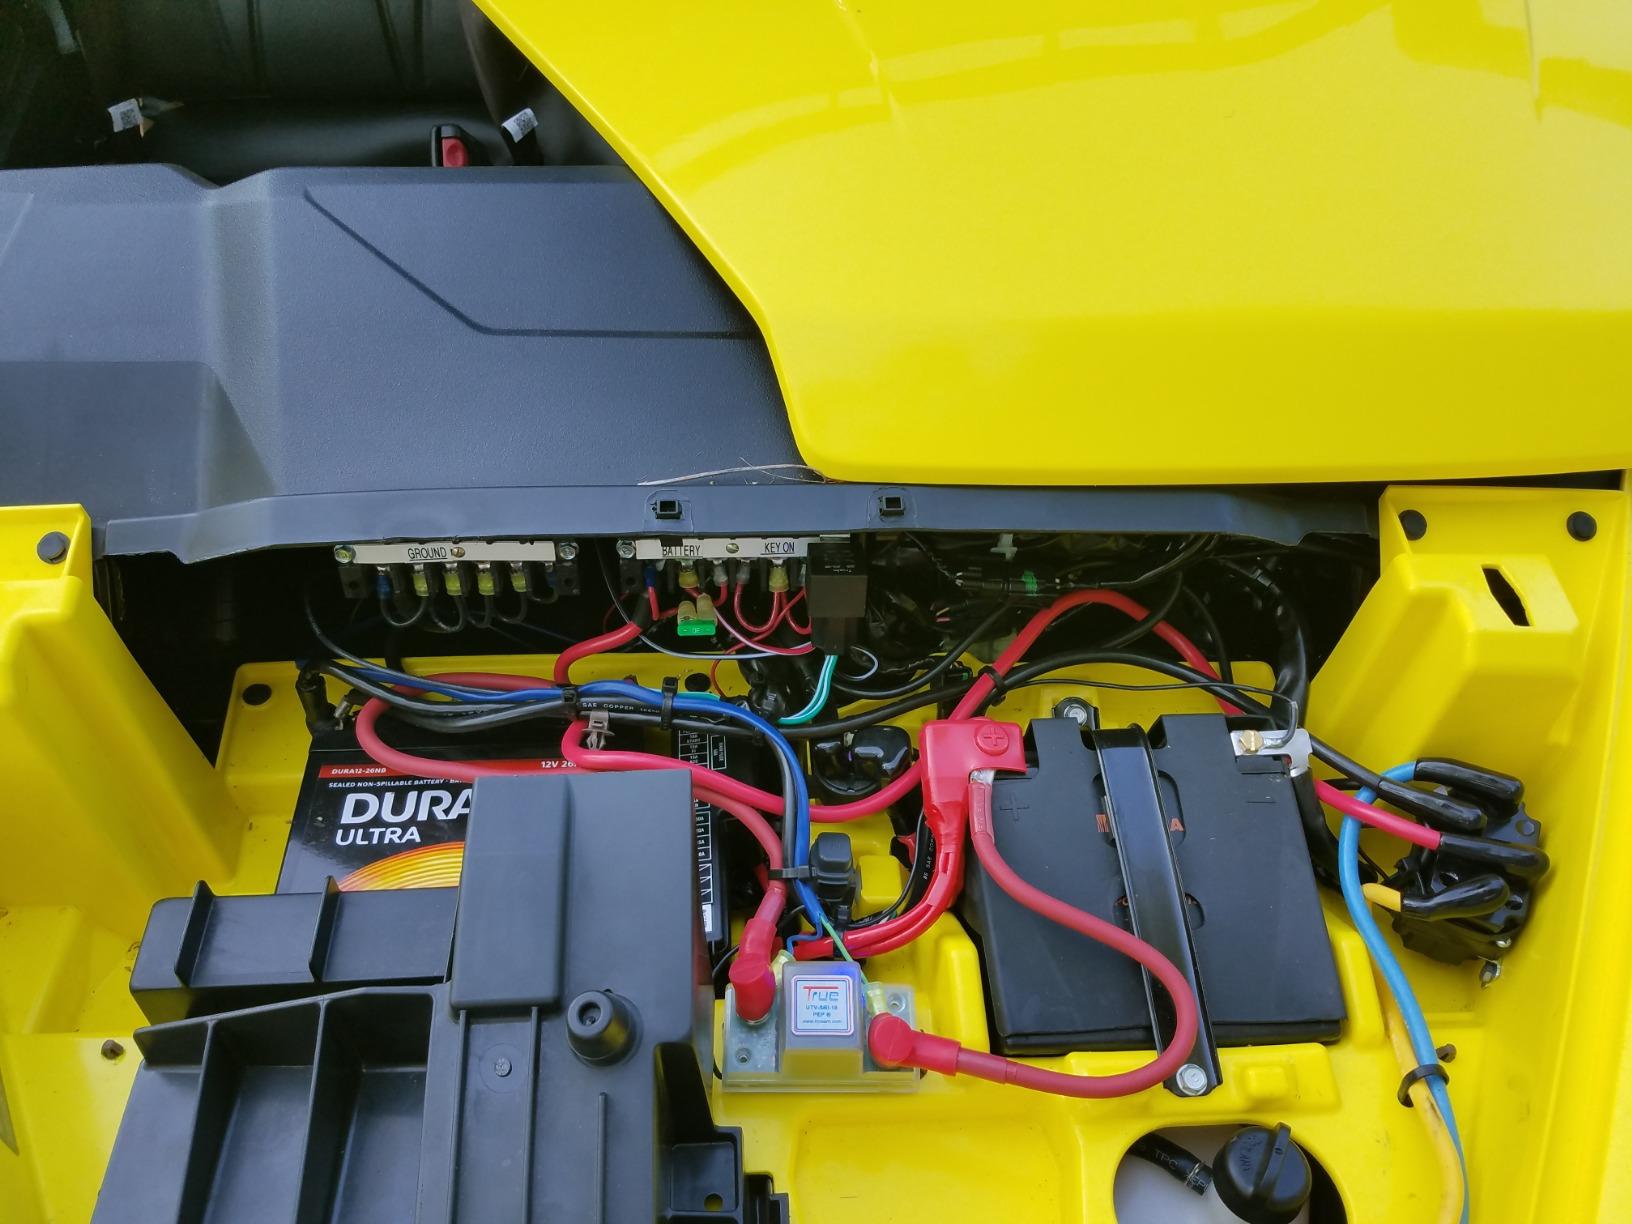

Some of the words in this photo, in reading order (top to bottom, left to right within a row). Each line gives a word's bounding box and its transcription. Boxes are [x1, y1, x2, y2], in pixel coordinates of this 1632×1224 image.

[408, 547, 447, 559] GROUND
[662, 544, 701, 556] BATTERY
[764, 542, 780, 553] KEY
[783, 542, 795, 552] ON
[541, 760, 559, 768] 12V
[560, 760, 577, 768] 26
[357, 780, 412, 788] NON-SPILLABLE
[413, 778, 445, 786] BATTERY
[340, 789, 473, 825] DURA
[335, 826, 422, 846] ULTRA
